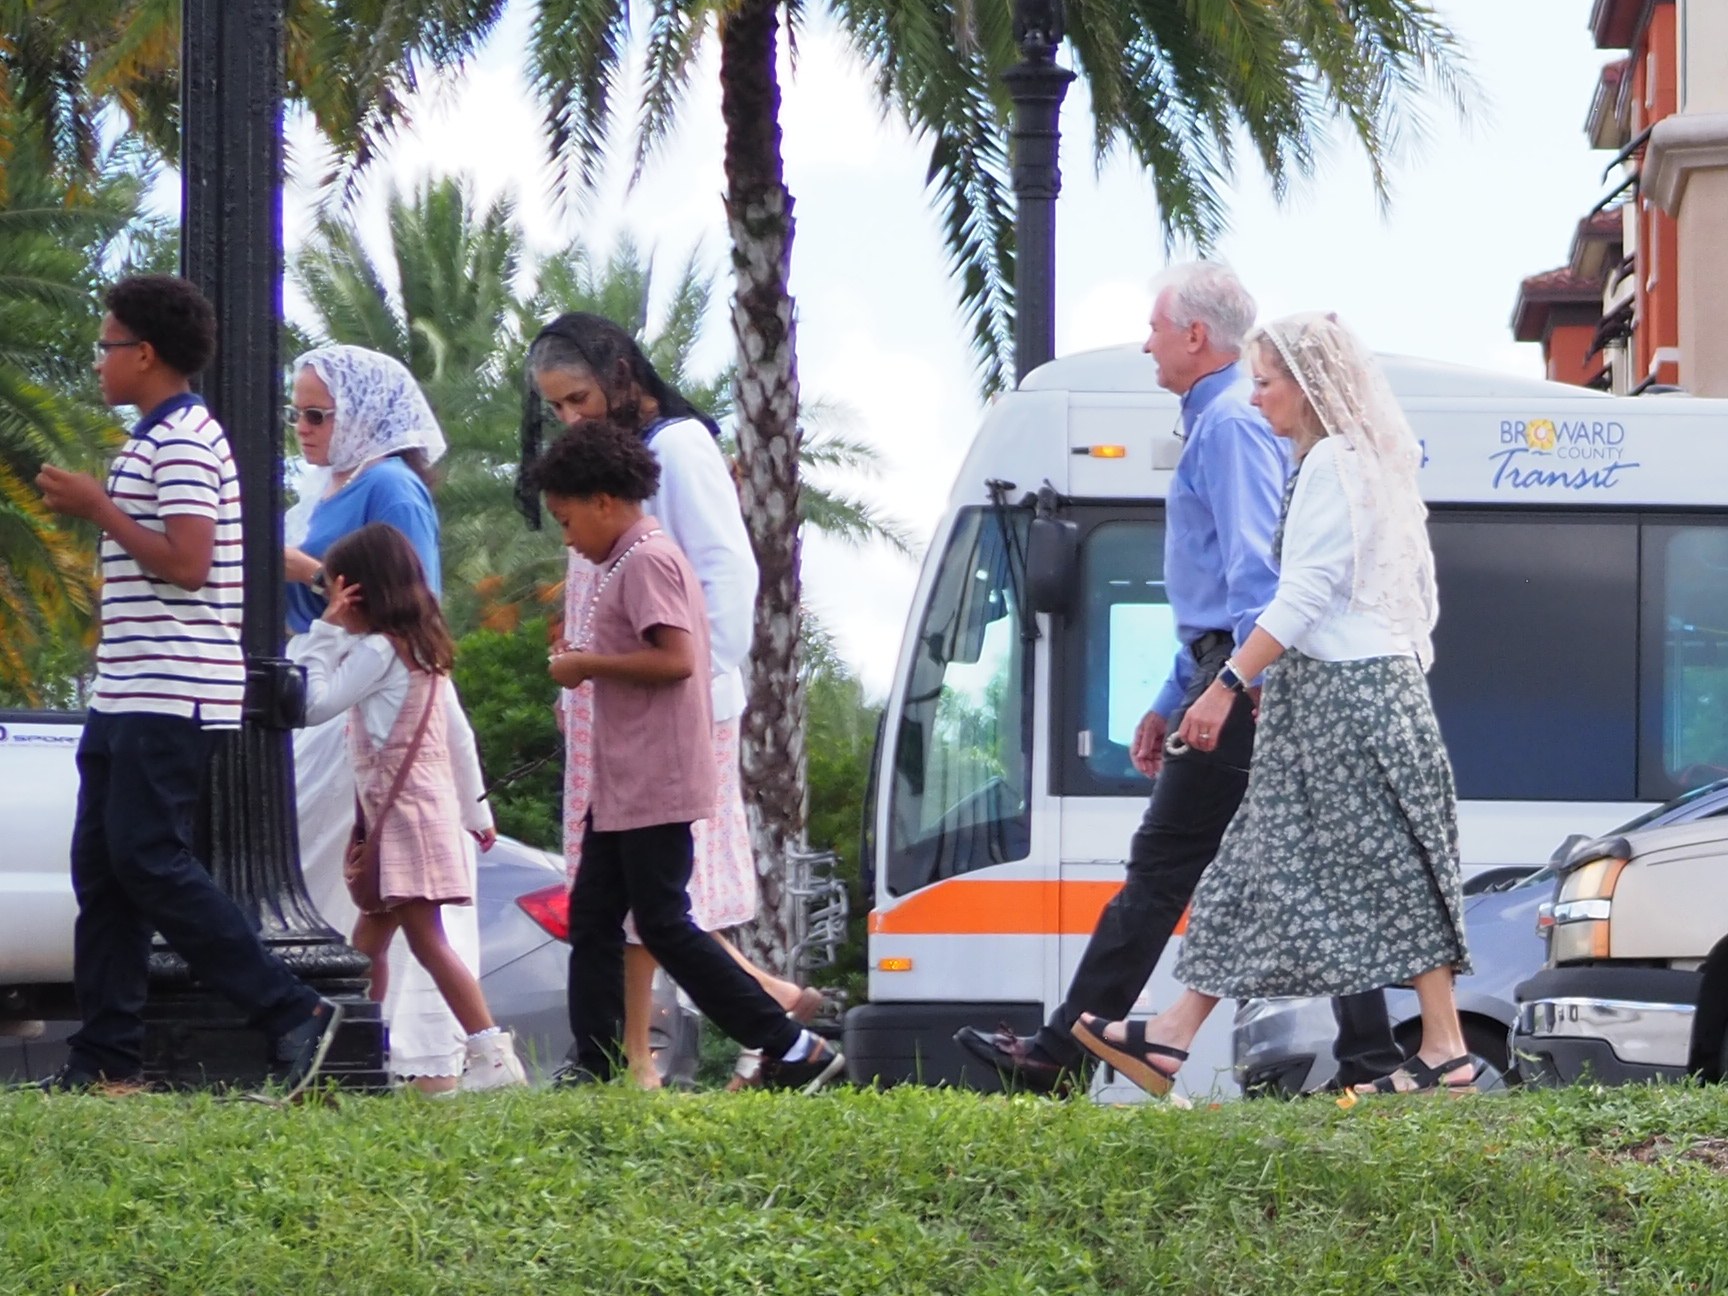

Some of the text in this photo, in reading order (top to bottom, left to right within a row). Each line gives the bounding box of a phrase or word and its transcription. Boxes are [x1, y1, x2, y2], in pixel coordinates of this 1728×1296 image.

[1500, 419, 1625, 448] BROWARD
[1556, 446, 1624, 460] COUNTY
[1488, 447, 1640, 490] Transit
[13, 735, 81, 743] SPOR
